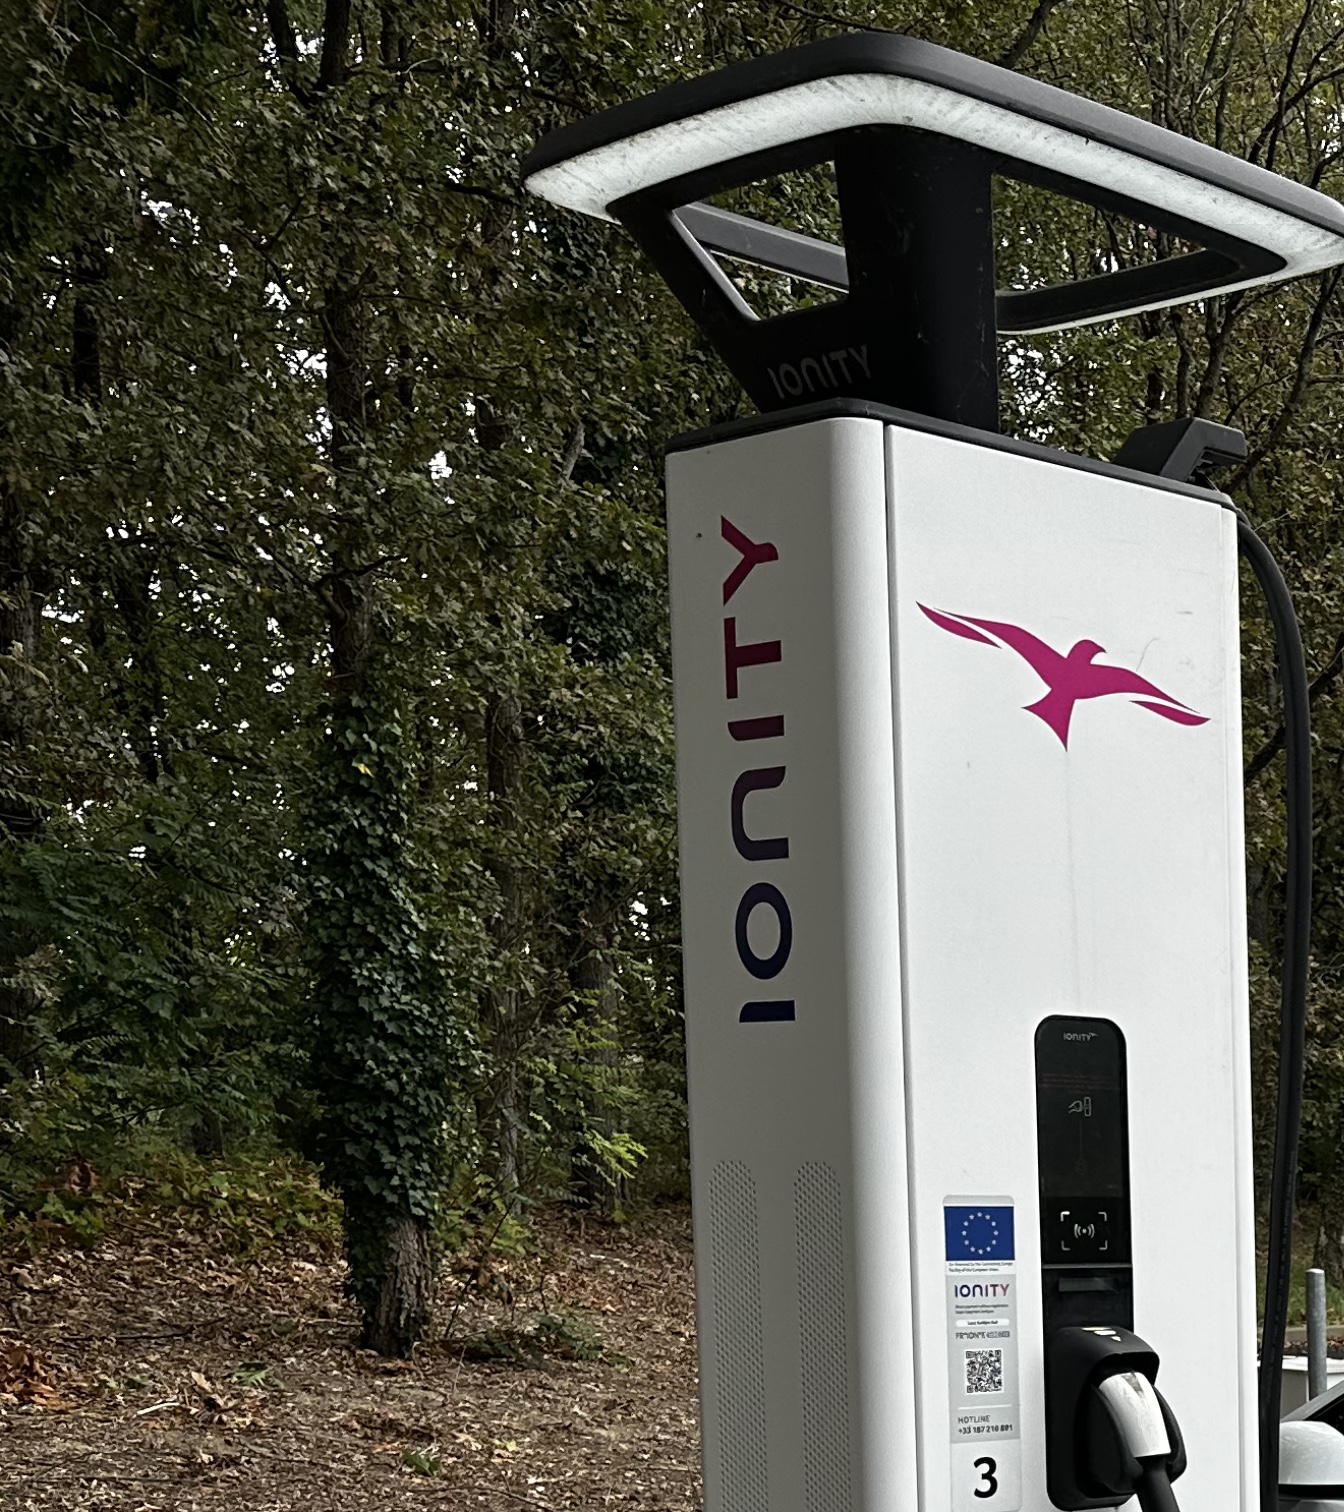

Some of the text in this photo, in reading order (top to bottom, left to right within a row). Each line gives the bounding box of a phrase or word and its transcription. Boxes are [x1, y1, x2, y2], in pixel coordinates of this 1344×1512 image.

[766, 344, 872, 400] IONITY
[719, 514, 796, 1024] IONITY
[954, 1283, 1010, 1298] IONITY
[957, 1415, 990, 1424] HOTLINE
[972, 1455, 999, 1499] 3
